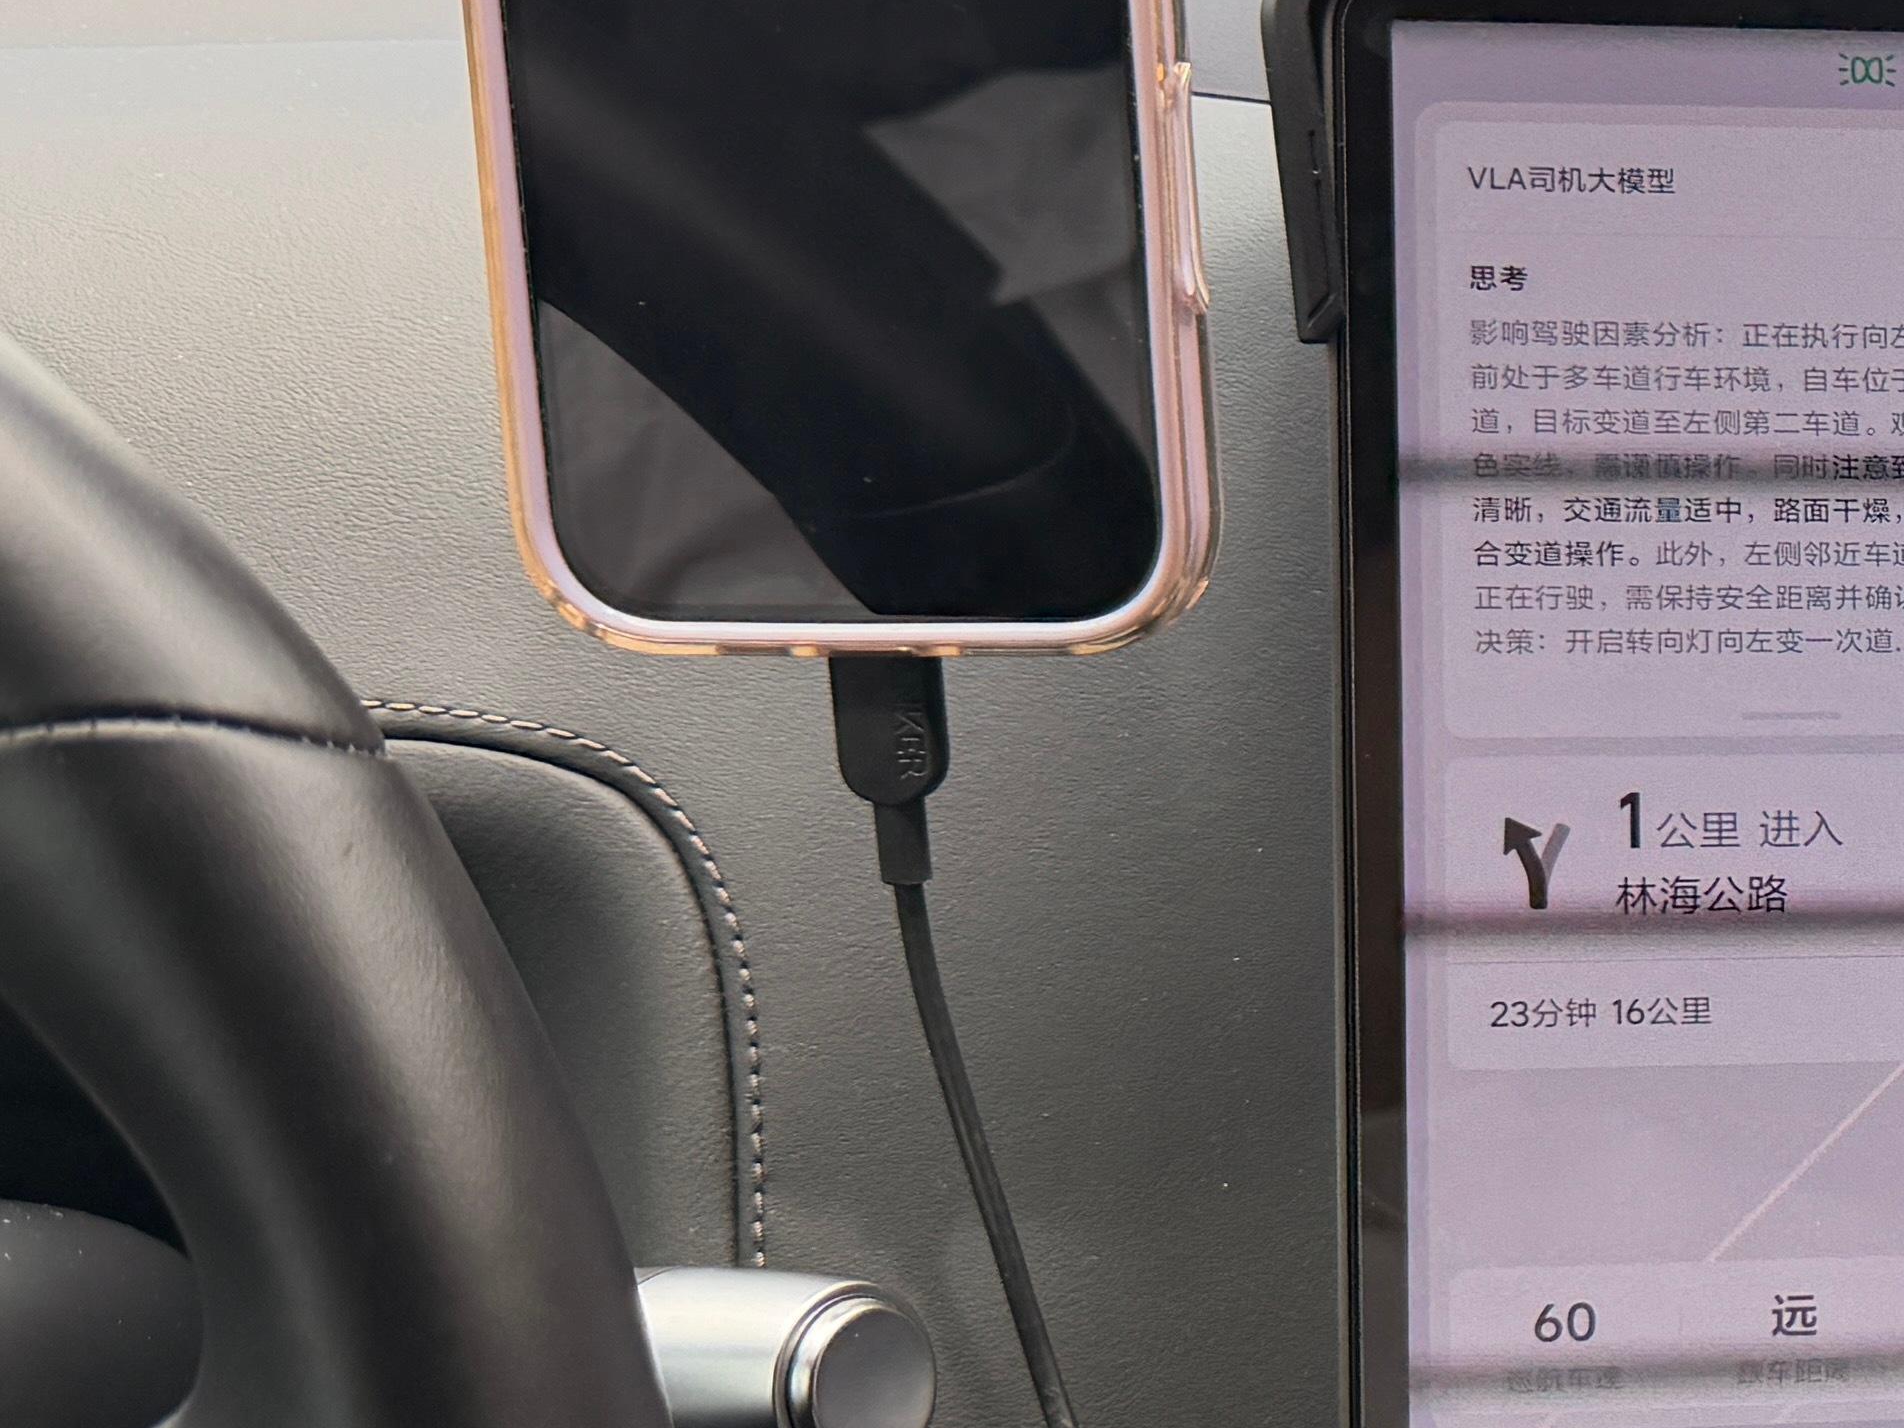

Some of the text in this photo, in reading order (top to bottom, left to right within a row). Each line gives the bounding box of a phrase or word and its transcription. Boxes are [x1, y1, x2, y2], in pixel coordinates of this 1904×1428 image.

[1467, 165, 1676, 195] VLA司机大模型
[1469, 265, 1529, 292] 思考
[893, 692, 929, 780] KER
[1759, 808, 1844, 849] 进入
[1616, 875, 1790, 916] 林海公路
[1490, 996, 1713, 1029] 23分钟 16公里
[1533, 1301, 1597, 1343] 60
[1771, 1294, 1819, 1337] 远
